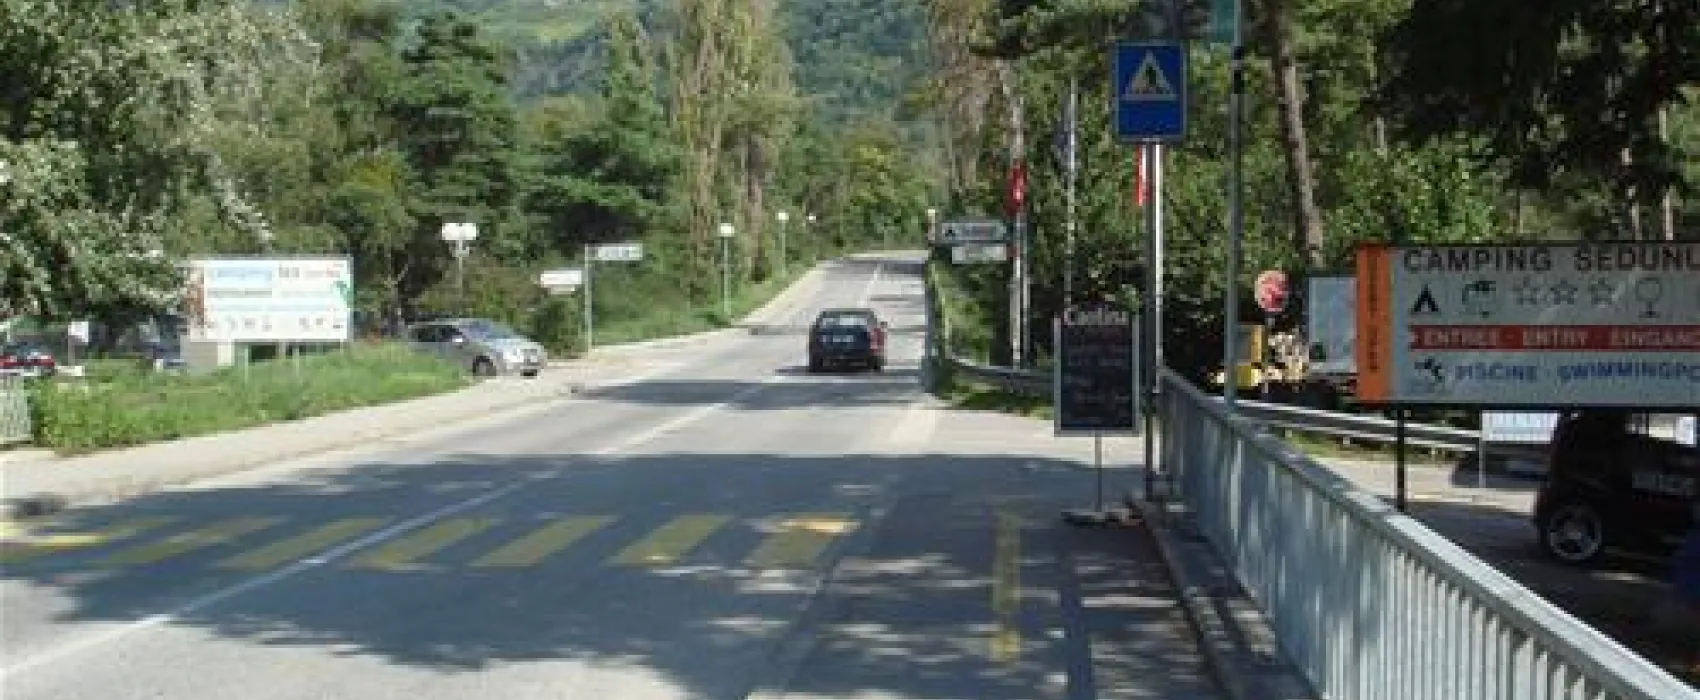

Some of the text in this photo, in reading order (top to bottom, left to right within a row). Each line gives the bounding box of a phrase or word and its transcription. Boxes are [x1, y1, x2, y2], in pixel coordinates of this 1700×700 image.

[1403, 248, 1551, 271] CAMPING
[1522, 328, 1588, 347] ENTRY
[1455, 364, 1537, 381] PISCINE
